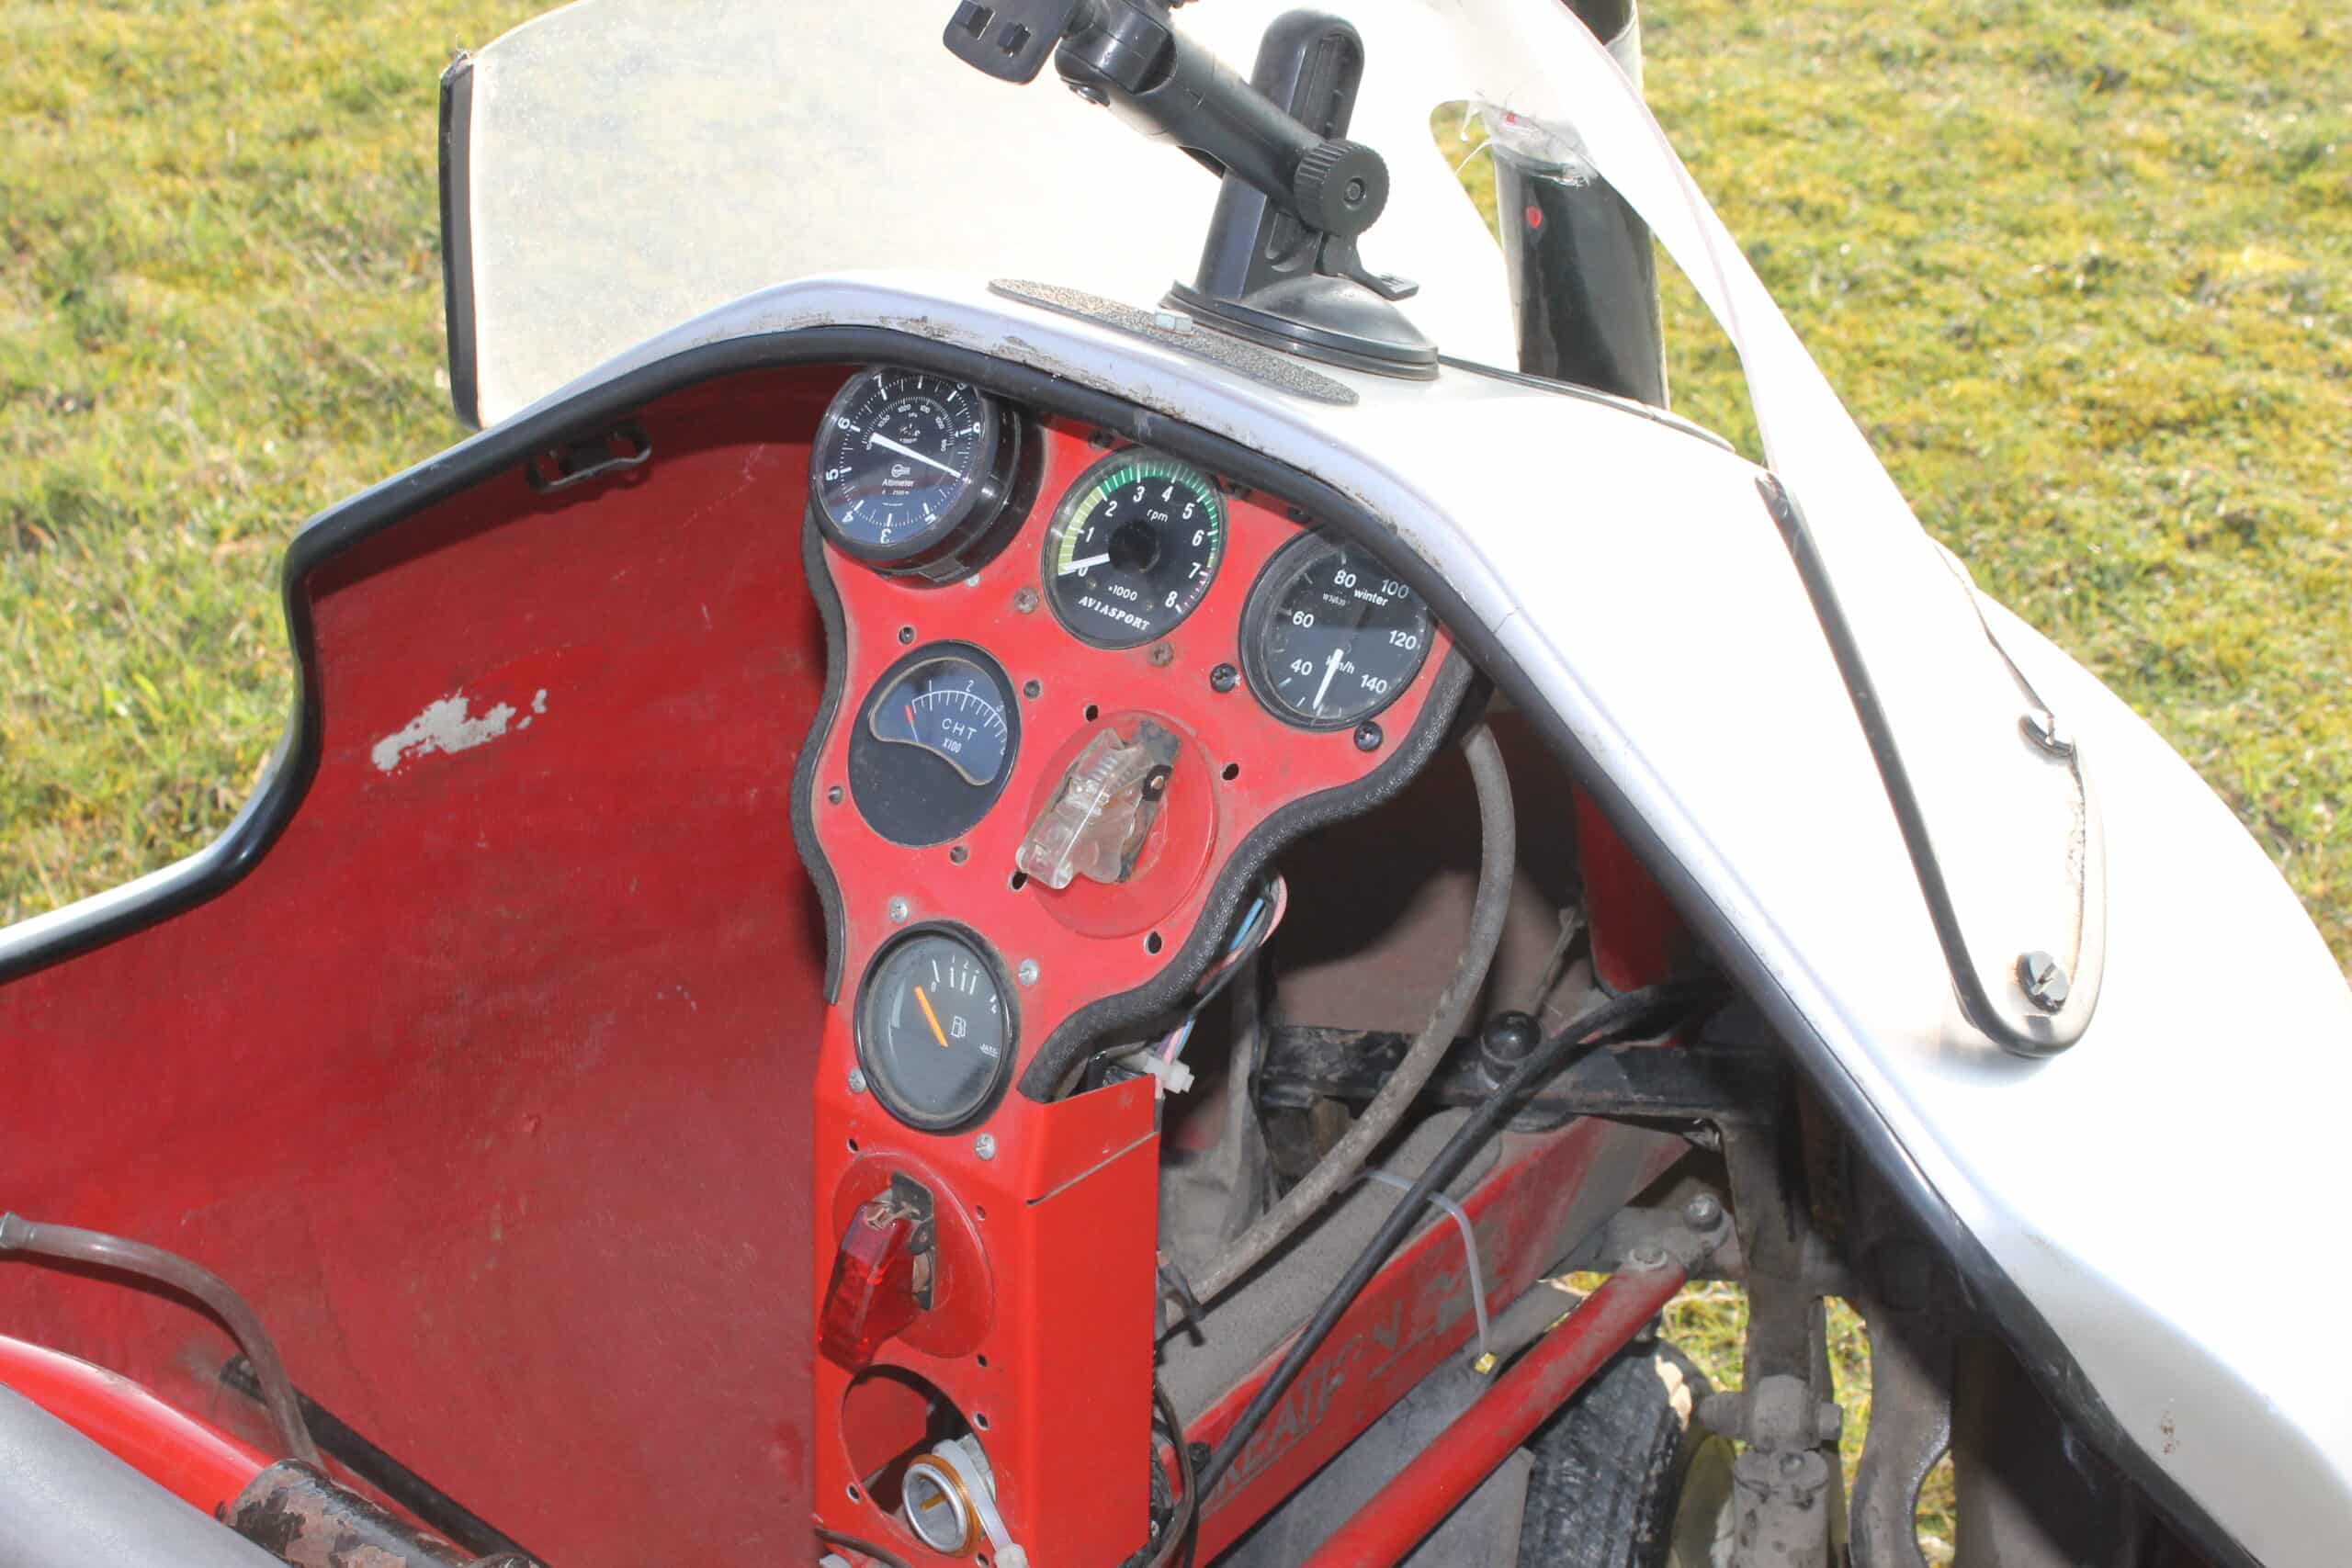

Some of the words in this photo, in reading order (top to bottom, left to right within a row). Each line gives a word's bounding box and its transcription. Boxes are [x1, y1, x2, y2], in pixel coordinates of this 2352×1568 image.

[874, 374, 883, 388] 7
[837, 416, 852, 430] 6
[826, 468, 839, 480] 5
[1133, 486, 1145, 502] 3
[1161, 486, 1174, 502] 4
[1104, 501, 1118, 517] 2
[1147, 509, 1169, 523] rpm
[1182, 502, 1194, 519] 5
[880, 528, 892, 545] 3
[1085, 526, 1095, 543] 1
[1192, 529, 1204, 547] 6
[1188, 562, 1201, 579] 7
[1334, 569, 1357, 588] 80
[1353, 588, 1388, 606] winter
[1381, 579, 1410, 599] 100
[1165, 591, 1178, 608] 8
[1079, 595, 1151, 631] AVIASPORT
[1293, 611, 1315, 628] 60
[1388, 630, 1417, 650] 120
[1290, 659, 1314, 676] 40
[966, 680, 974, 693] 2
[1360, 674, 1387, 694] 140
[942, 718, 978, 740] CHT
